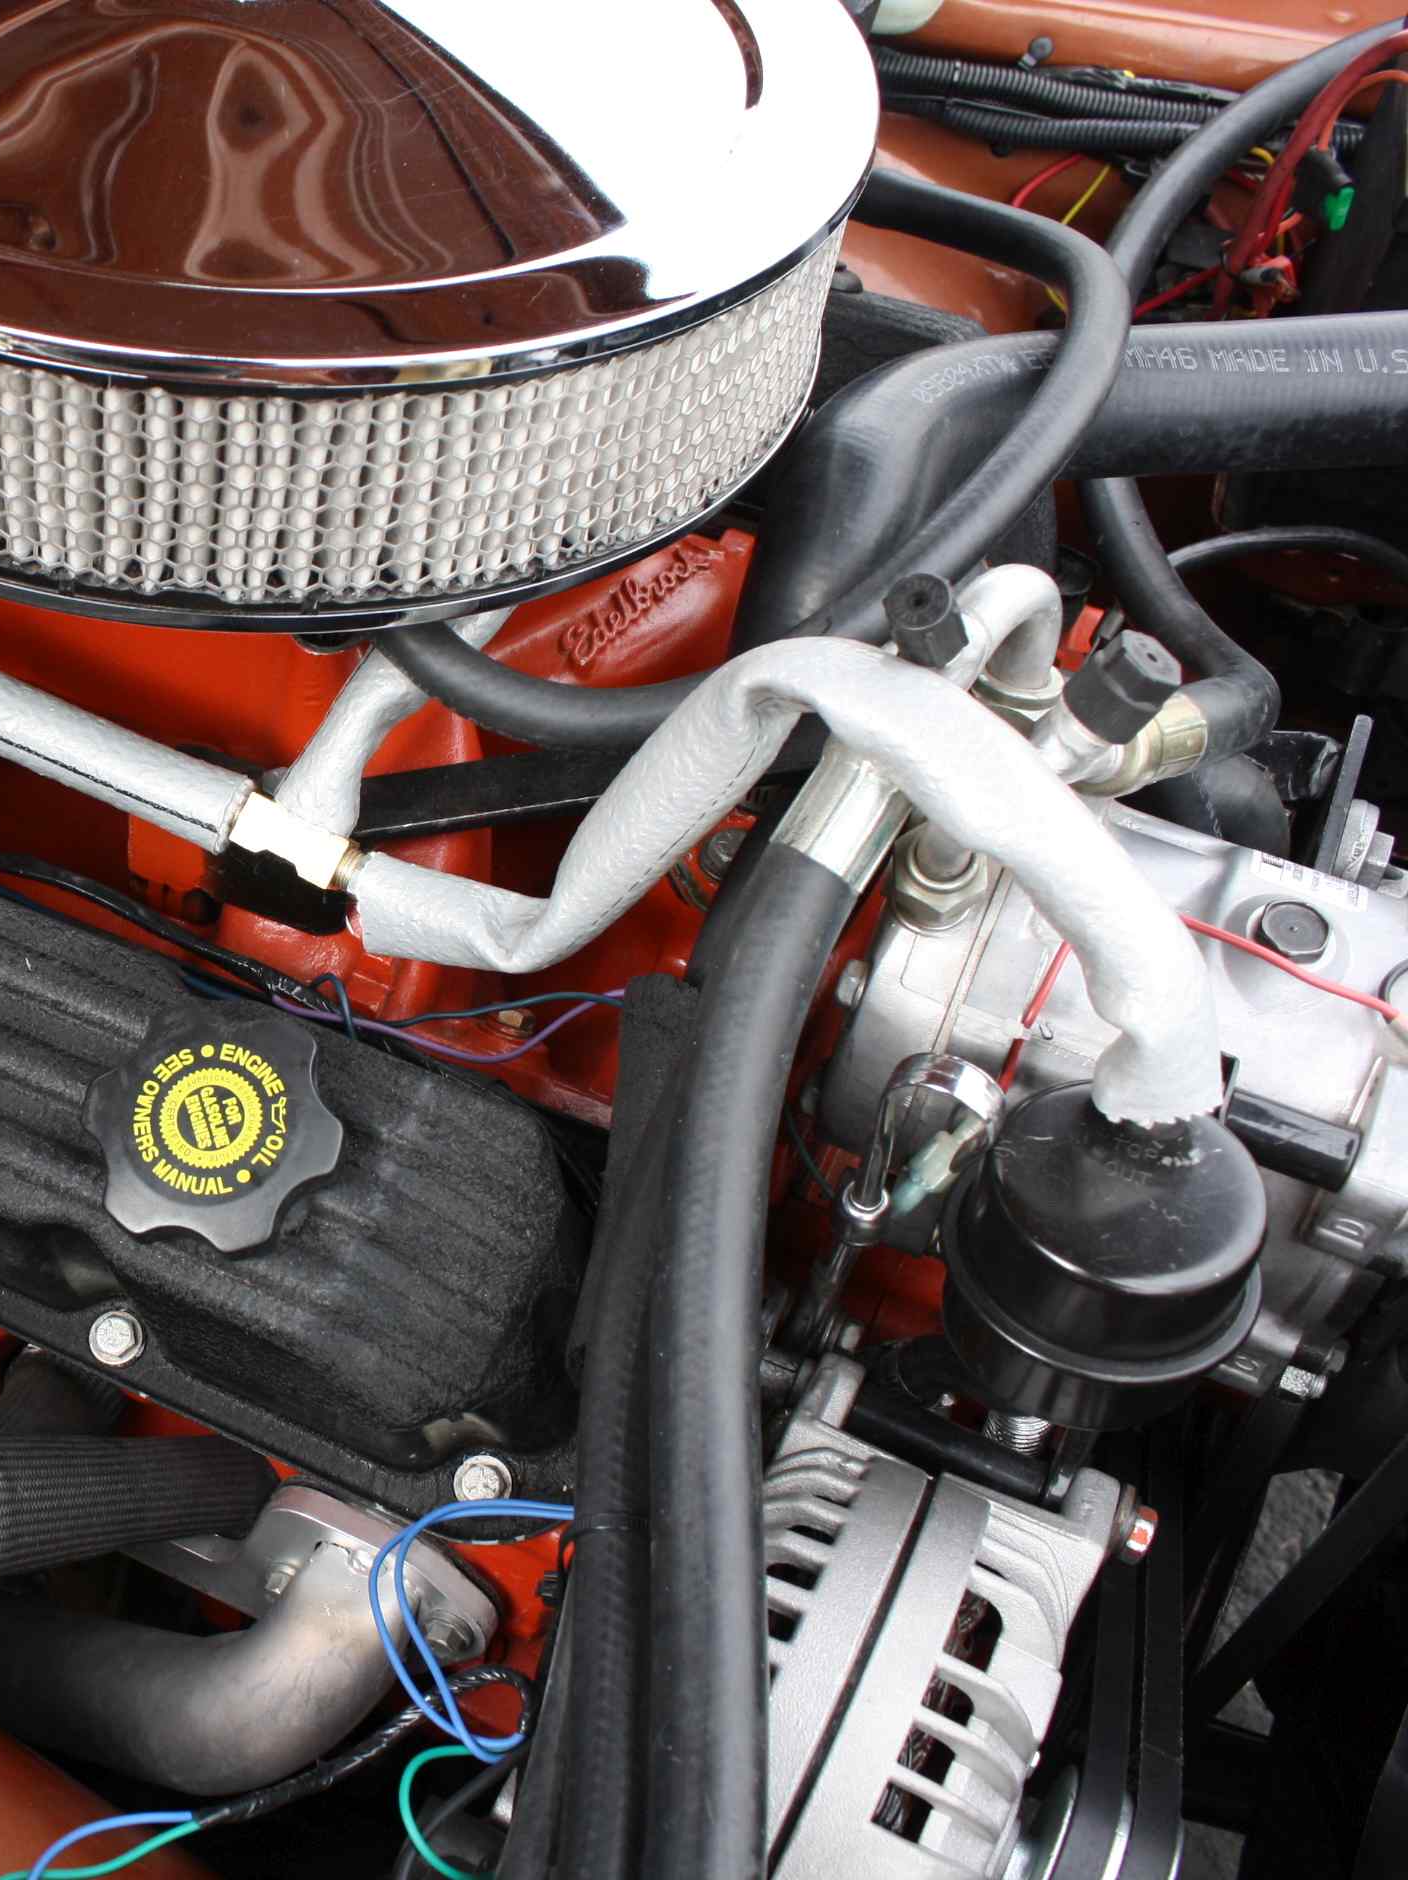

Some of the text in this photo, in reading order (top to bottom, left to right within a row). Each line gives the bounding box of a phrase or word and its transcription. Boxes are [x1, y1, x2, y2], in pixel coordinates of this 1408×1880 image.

[1207, 347, 1291, 376] MADE
[1303, 347, 1345, 376] IN
[153, 1048, 195, 1083] SEE
[219, 1043, 285, 1097] ENGINE
[133, 1080, 160, 1162] OWNERS
[184, 1094, 213, 1149] ENGINES
[200, 1086, 231, 1149] GASOLINE
[222, 1096, 242, 1126] FOR
[251, 1134, 284, 1167] OIL
[152, 1158, 233, 1196] MANUAL
